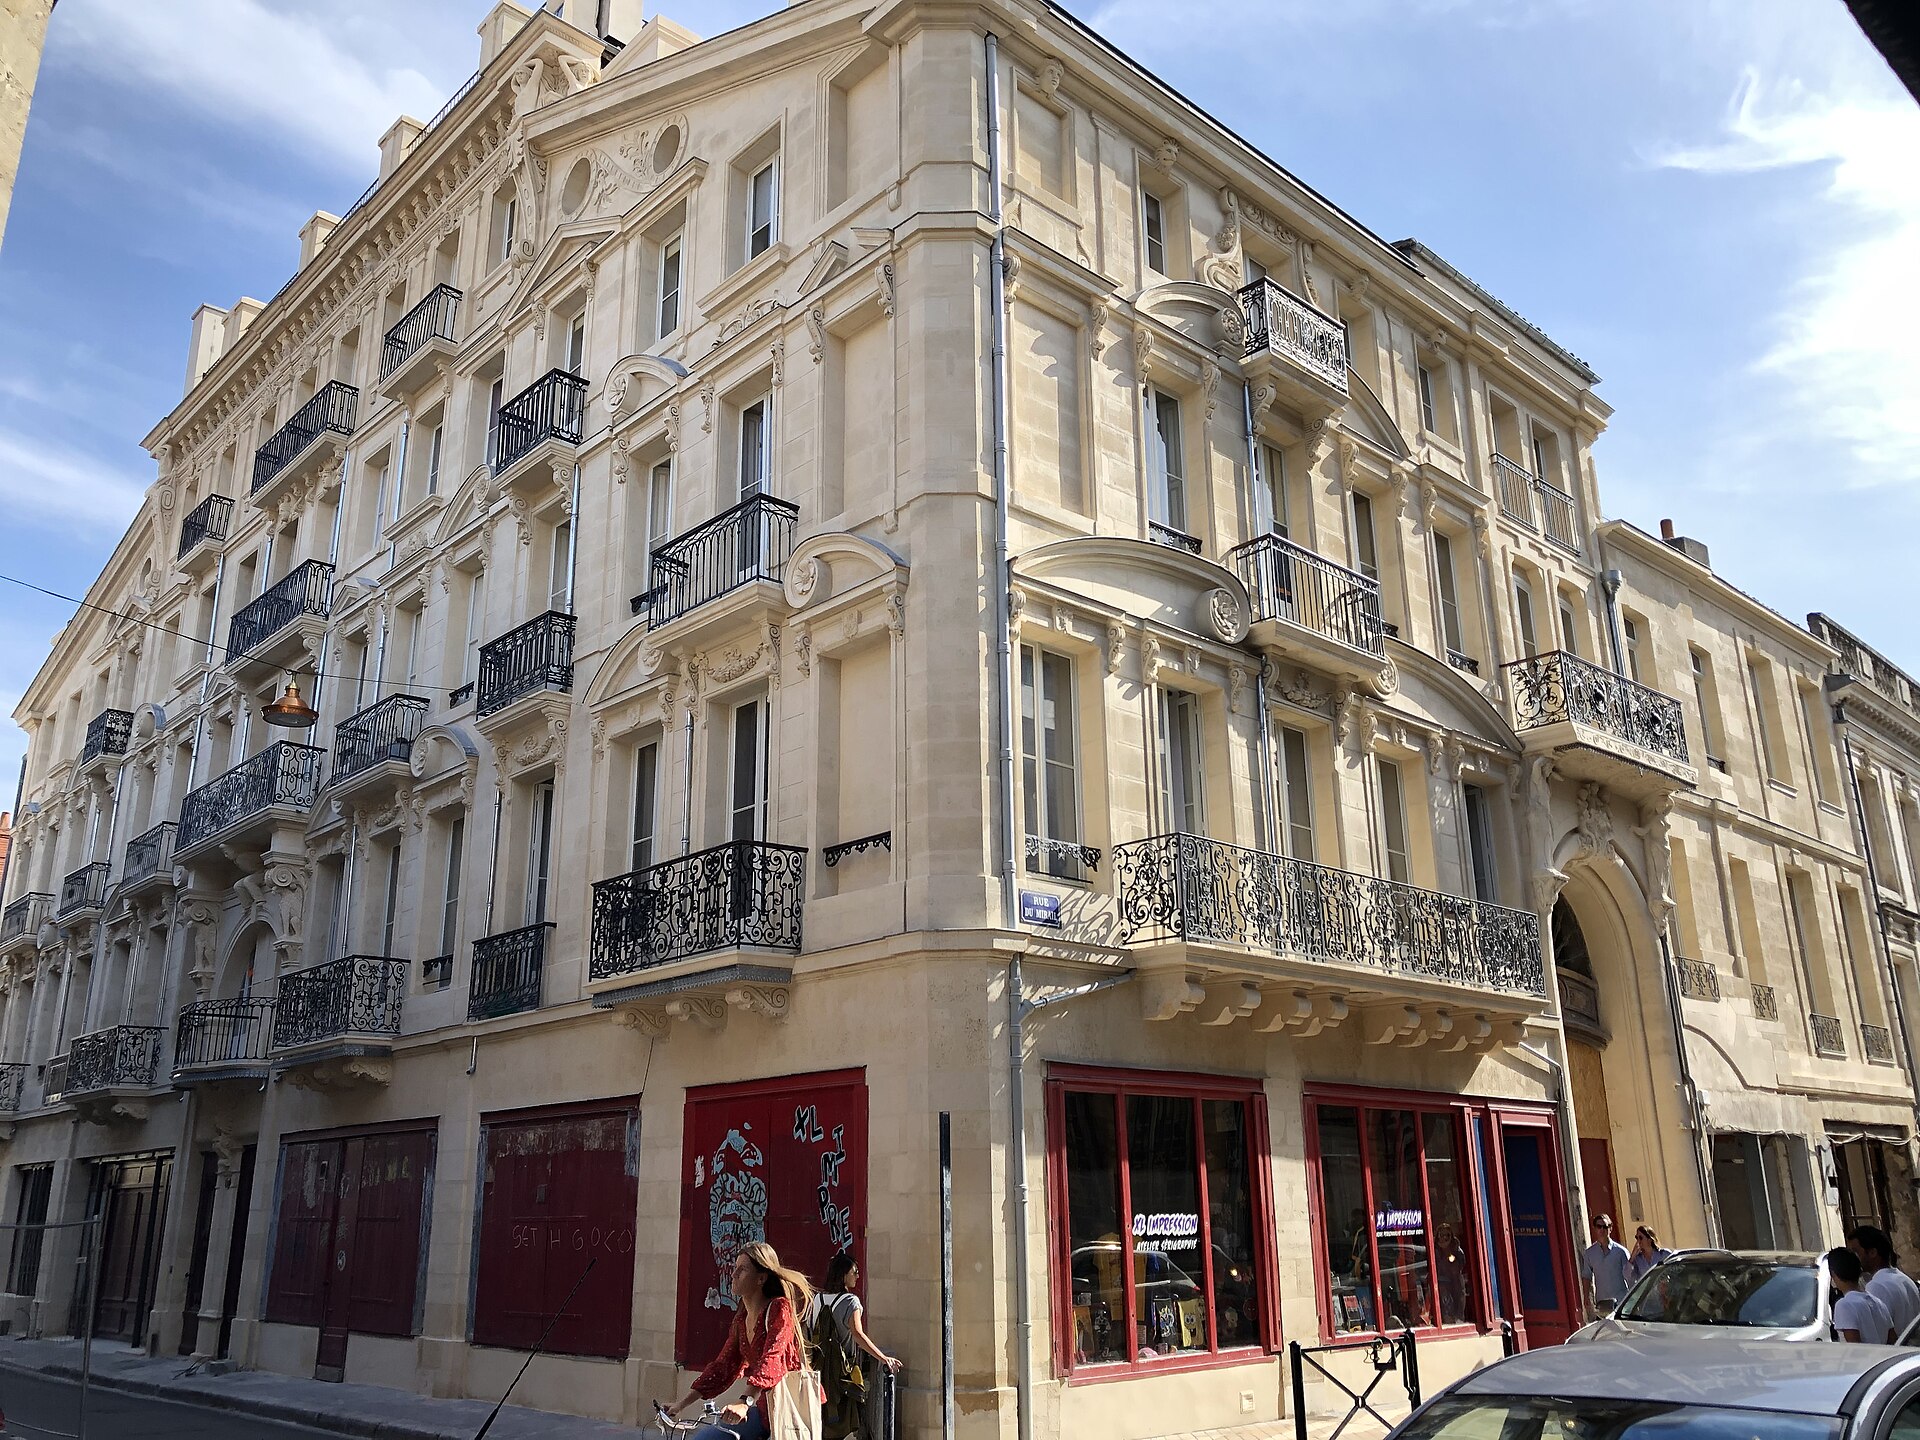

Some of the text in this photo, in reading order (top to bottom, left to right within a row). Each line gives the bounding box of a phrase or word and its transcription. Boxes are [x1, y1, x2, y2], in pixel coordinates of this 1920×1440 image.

[1033, 896, 1049, 907] RUE
[1024, 907, 1057, 920] DU MIRAIL
[793, 1105, 824, 1143] XL
[1132, 1213, 1198, 1236] XL IMPRESSION
[1376, 1209, 1422, 1229] XL IMPRESSION
[1136, 1240, 1160, 1252] ATELIER
